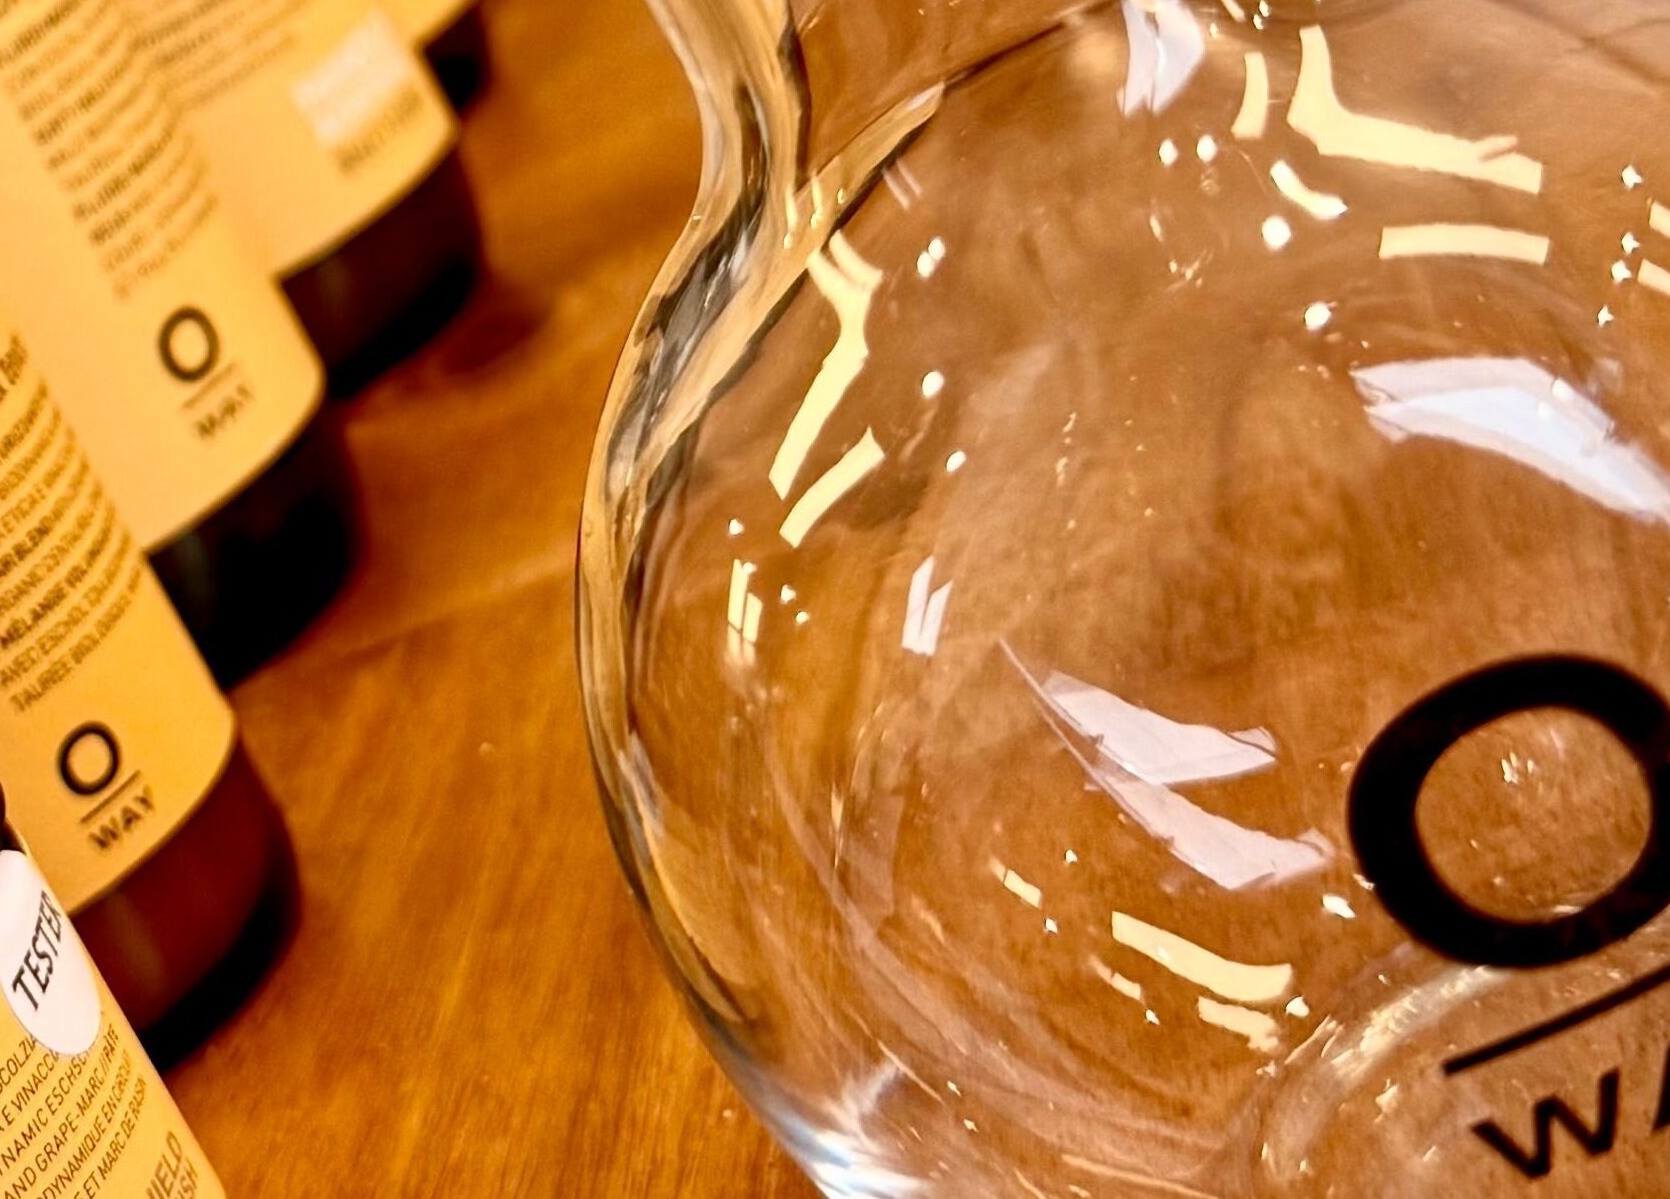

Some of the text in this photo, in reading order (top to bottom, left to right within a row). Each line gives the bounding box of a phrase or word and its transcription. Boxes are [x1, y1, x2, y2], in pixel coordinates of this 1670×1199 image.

[159, 305, 220, 383] O
[58, 721, 119, 796] O
[89, 783, 156, 851] WAY
[2, 1105, 15, 1126] E
[35, 1067, 105, 1172] GRAPE-MARC
[37, 1115, 107, 1199] DYNAMIQUE
[101, 1101, 118, 1124] EN
[83, 1171, 101, 1199] ET
[98, 1131, 126, 1181] MARC
[120, 1111, 135, 1138] DE
